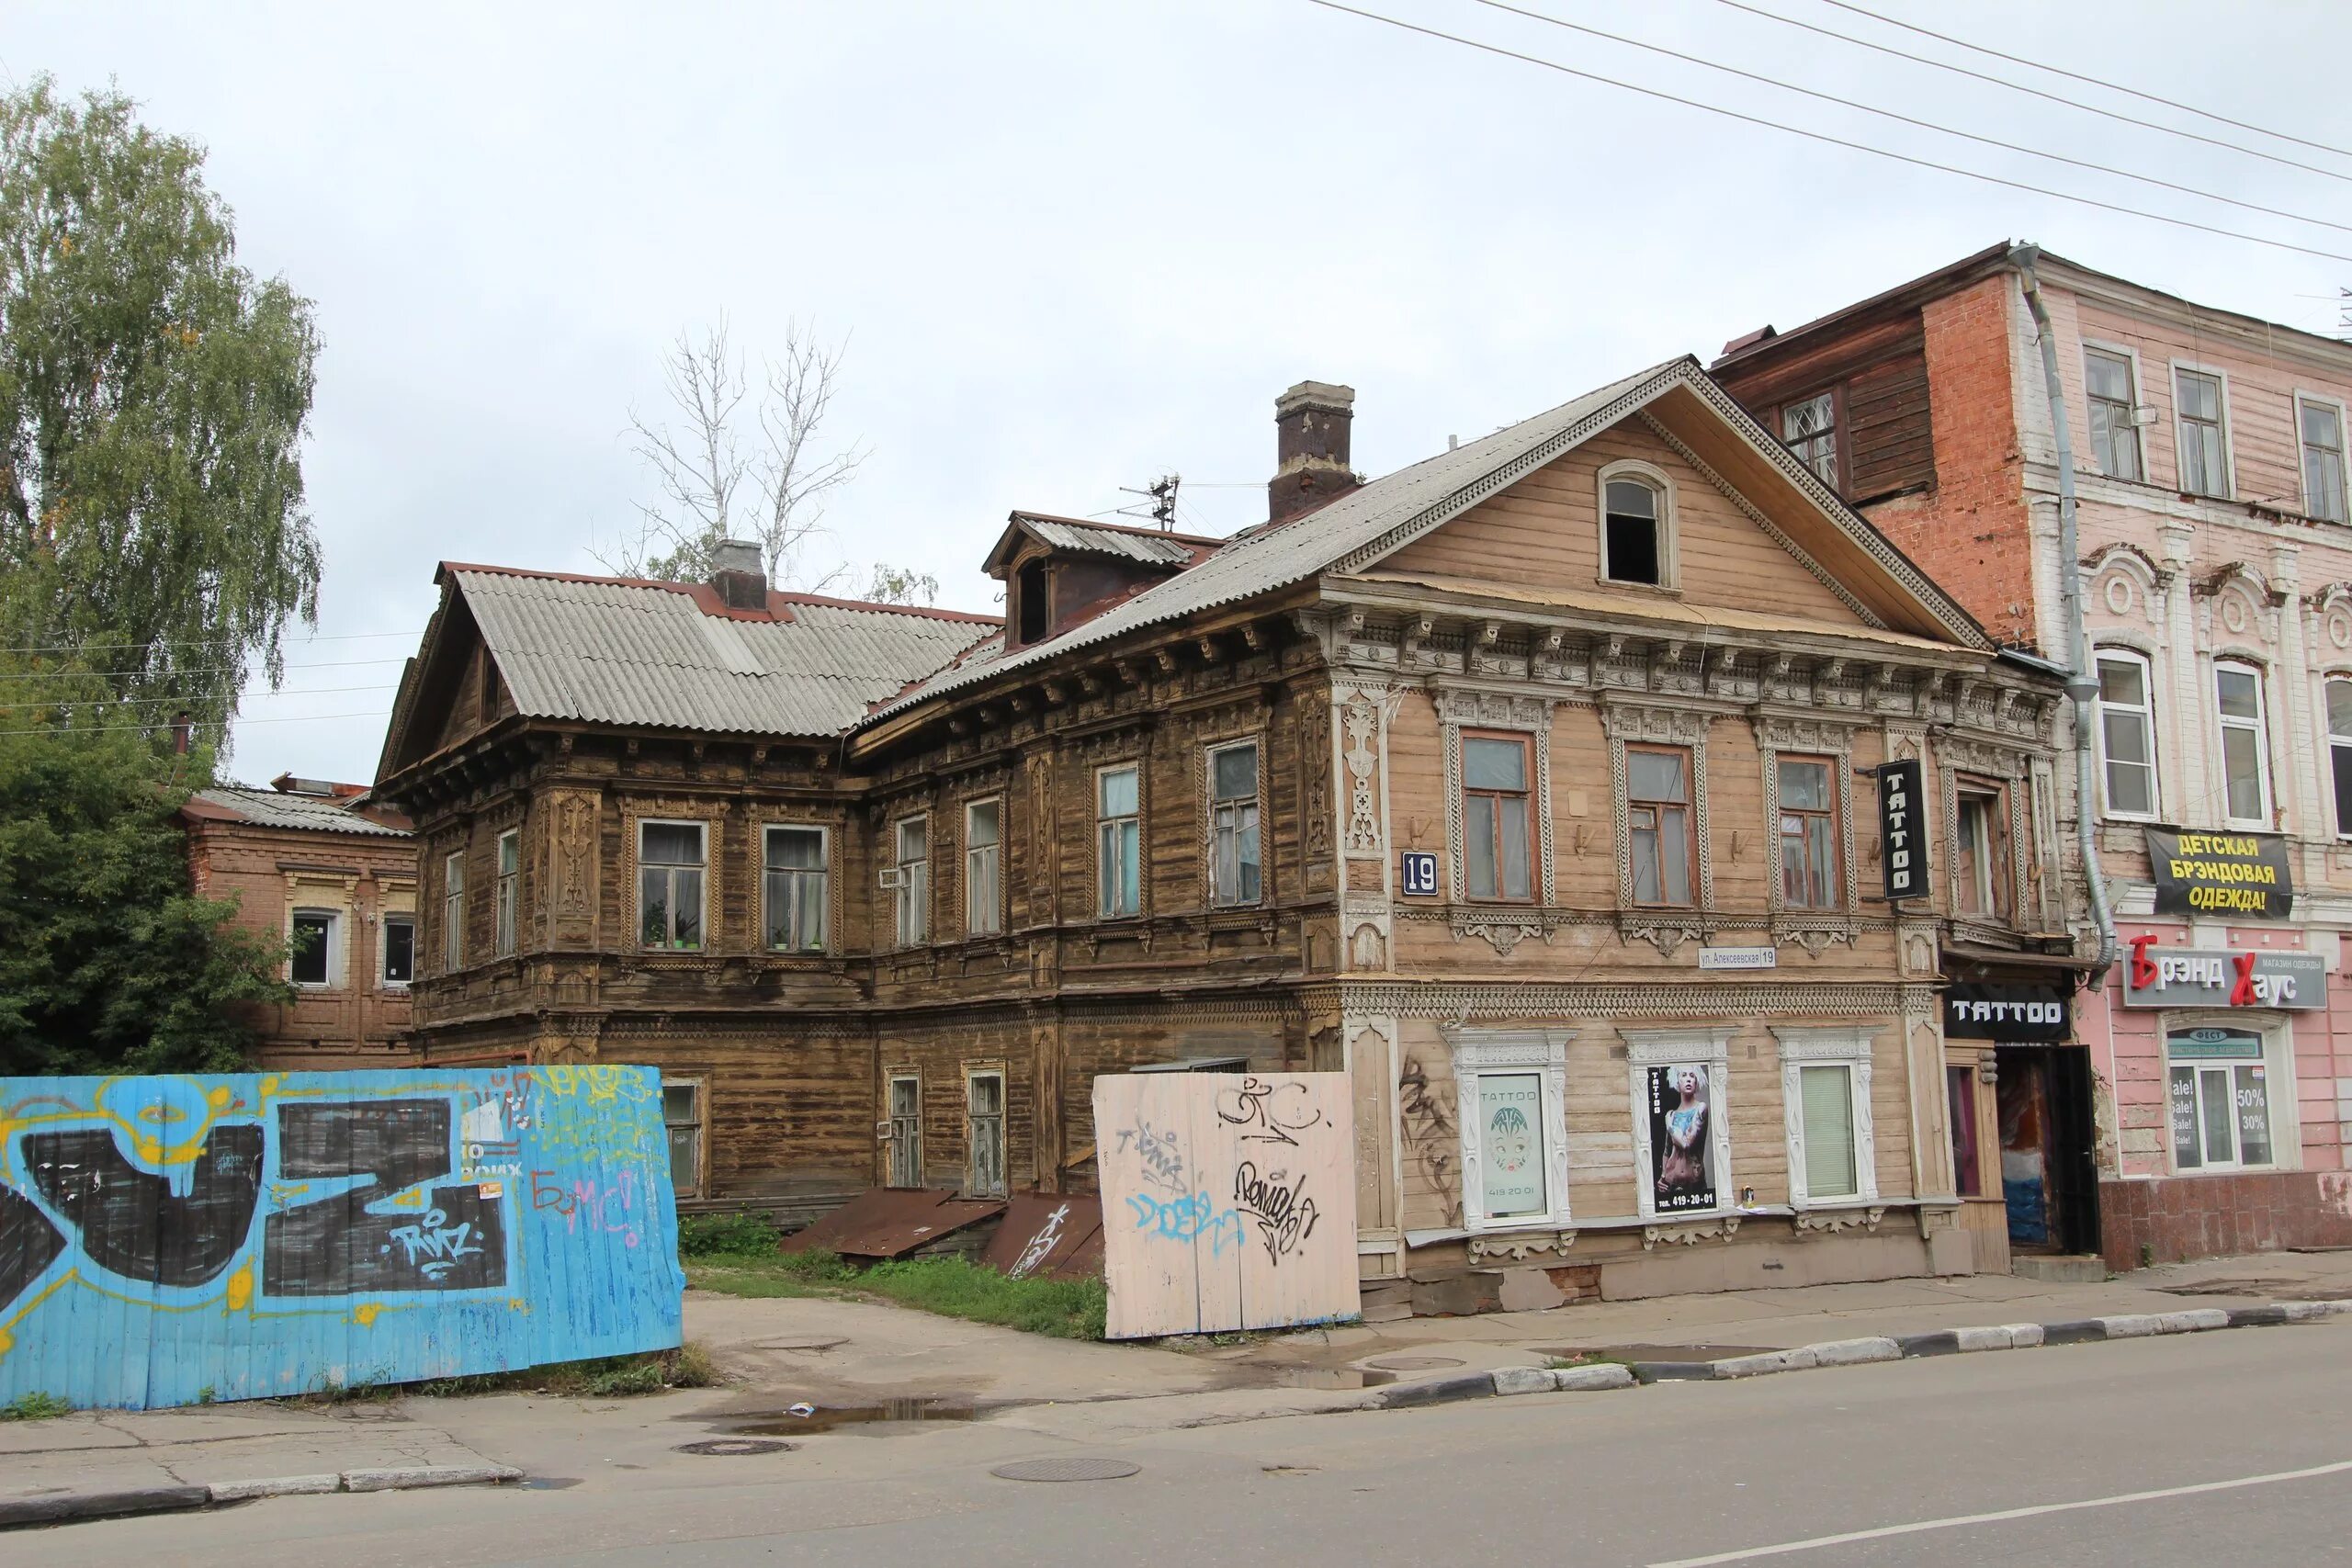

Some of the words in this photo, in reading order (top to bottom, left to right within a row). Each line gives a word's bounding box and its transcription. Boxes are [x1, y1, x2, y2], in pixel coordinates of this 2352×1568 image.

[1887, 773, 1910, 889] TATTOO
[2177, 835, 2259, 856] ДЕТСКАЯ
[1408, 857, 1435, 890] 19
[2170, 860, 2276, 885] БРЭНДОВАЯ
[2189, 886, 2267, 911] ОДЕЖДА!
[1713, 952, 1759, 964] Алексеевская
[1762, 951, 1773, 963] 19
[2262, 958, 2292, 969] МАГАЗИН
[2293, 960, 2321, 970] ОДЕЖДЫ
[2130, 935, 2225, 990] Брэнд
[2230, 953, 2297, 1007] Хаус
[1952, 1000, 2062, 1023] TATTOO
[1481, 1091, 1536, 1101] TATTOO
[1652, 1072, 1662, 1114] TATTOO
[2170, 1079, 2194, 1096] ale!
[2237, 1089, 2265, 1108] 50%
[2172, 1119, 2192, 1130] Sale!
[2243, 1115, 2265, 1130] 30%
[2176, 1136, 2191, 1145] Sale!
